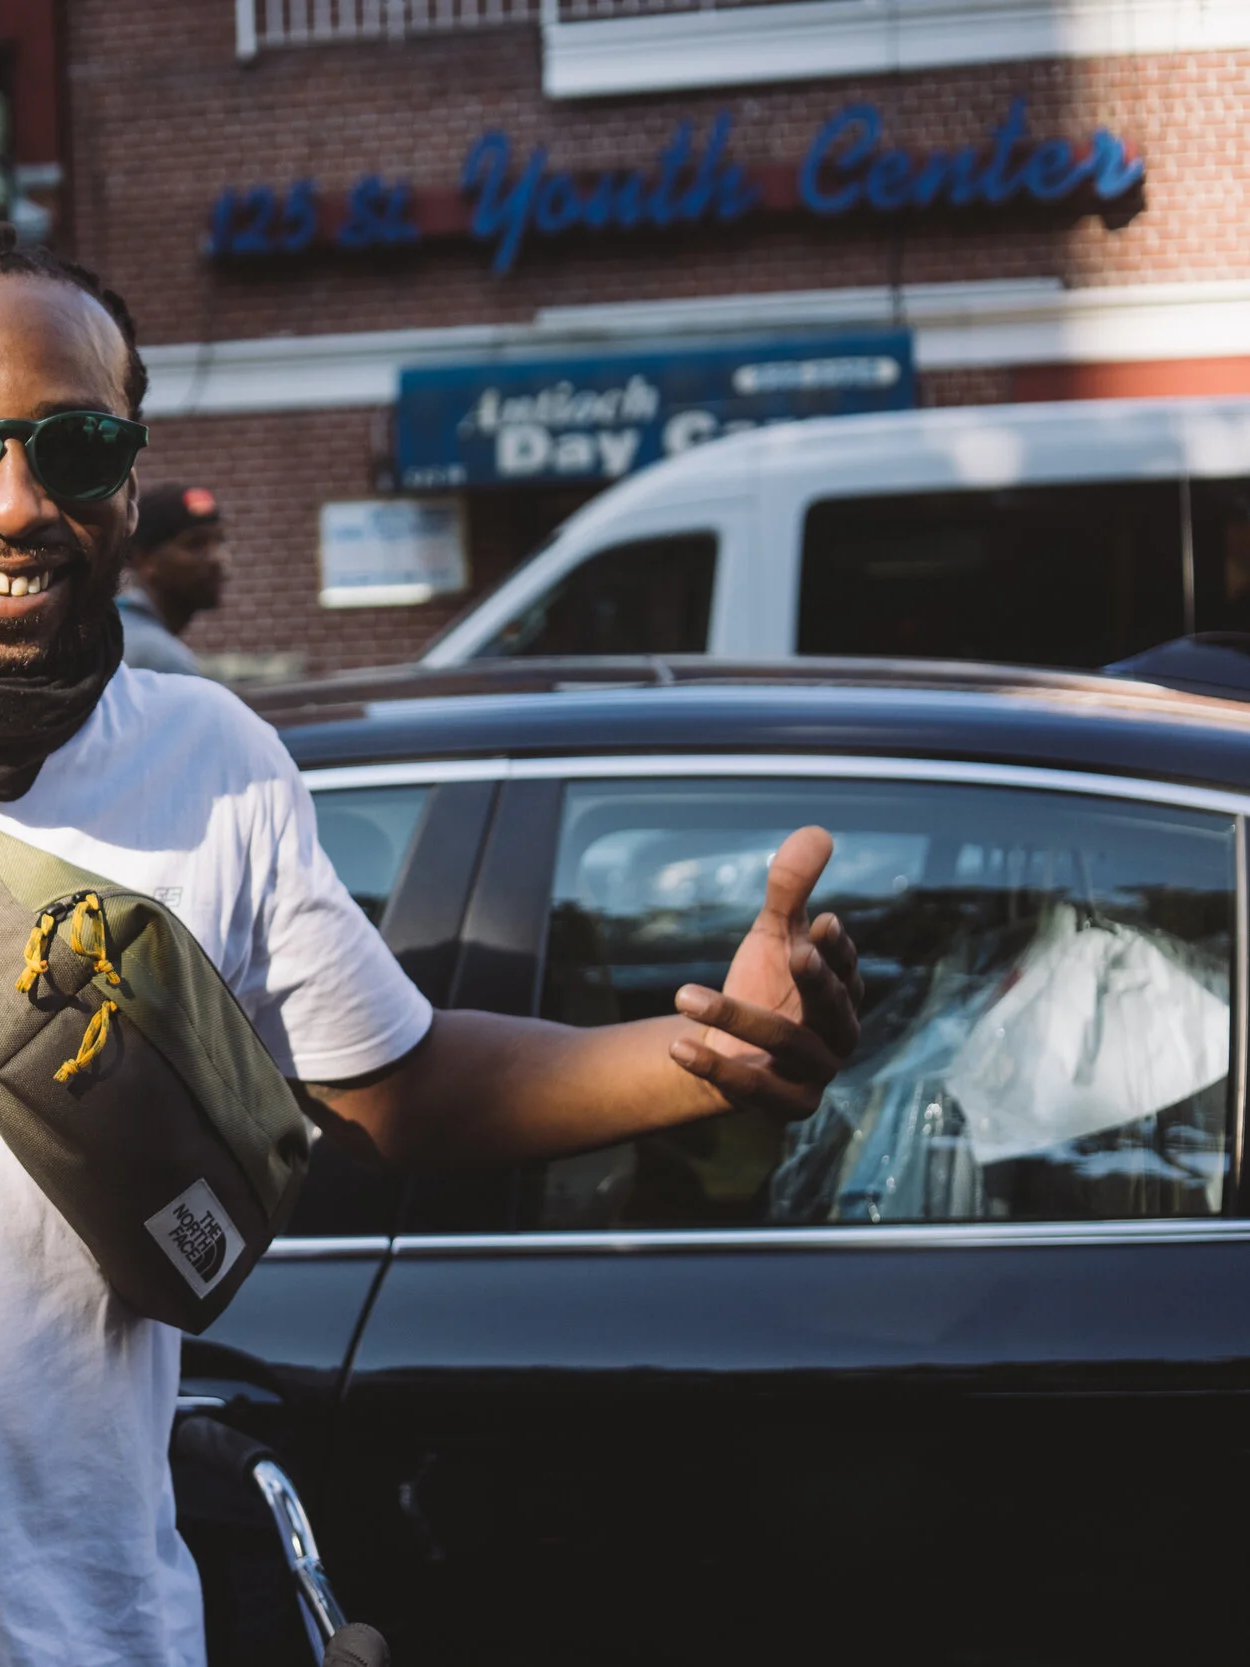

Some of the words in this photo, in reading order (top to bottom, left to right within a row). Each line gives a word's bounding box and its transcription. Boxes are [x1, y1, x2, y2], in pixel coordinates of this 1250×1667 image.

[205, 182, 319, 255] 125
[461, 108, 761, 277] Youth
[800, 95, 1144, 216] Center
[493, 423, 642, 477] Day
[168, 1226, 202, 1262] FACE
[172, 1203, 212, 1252] NORTH
[200, 1210, 223, 1240] THE
